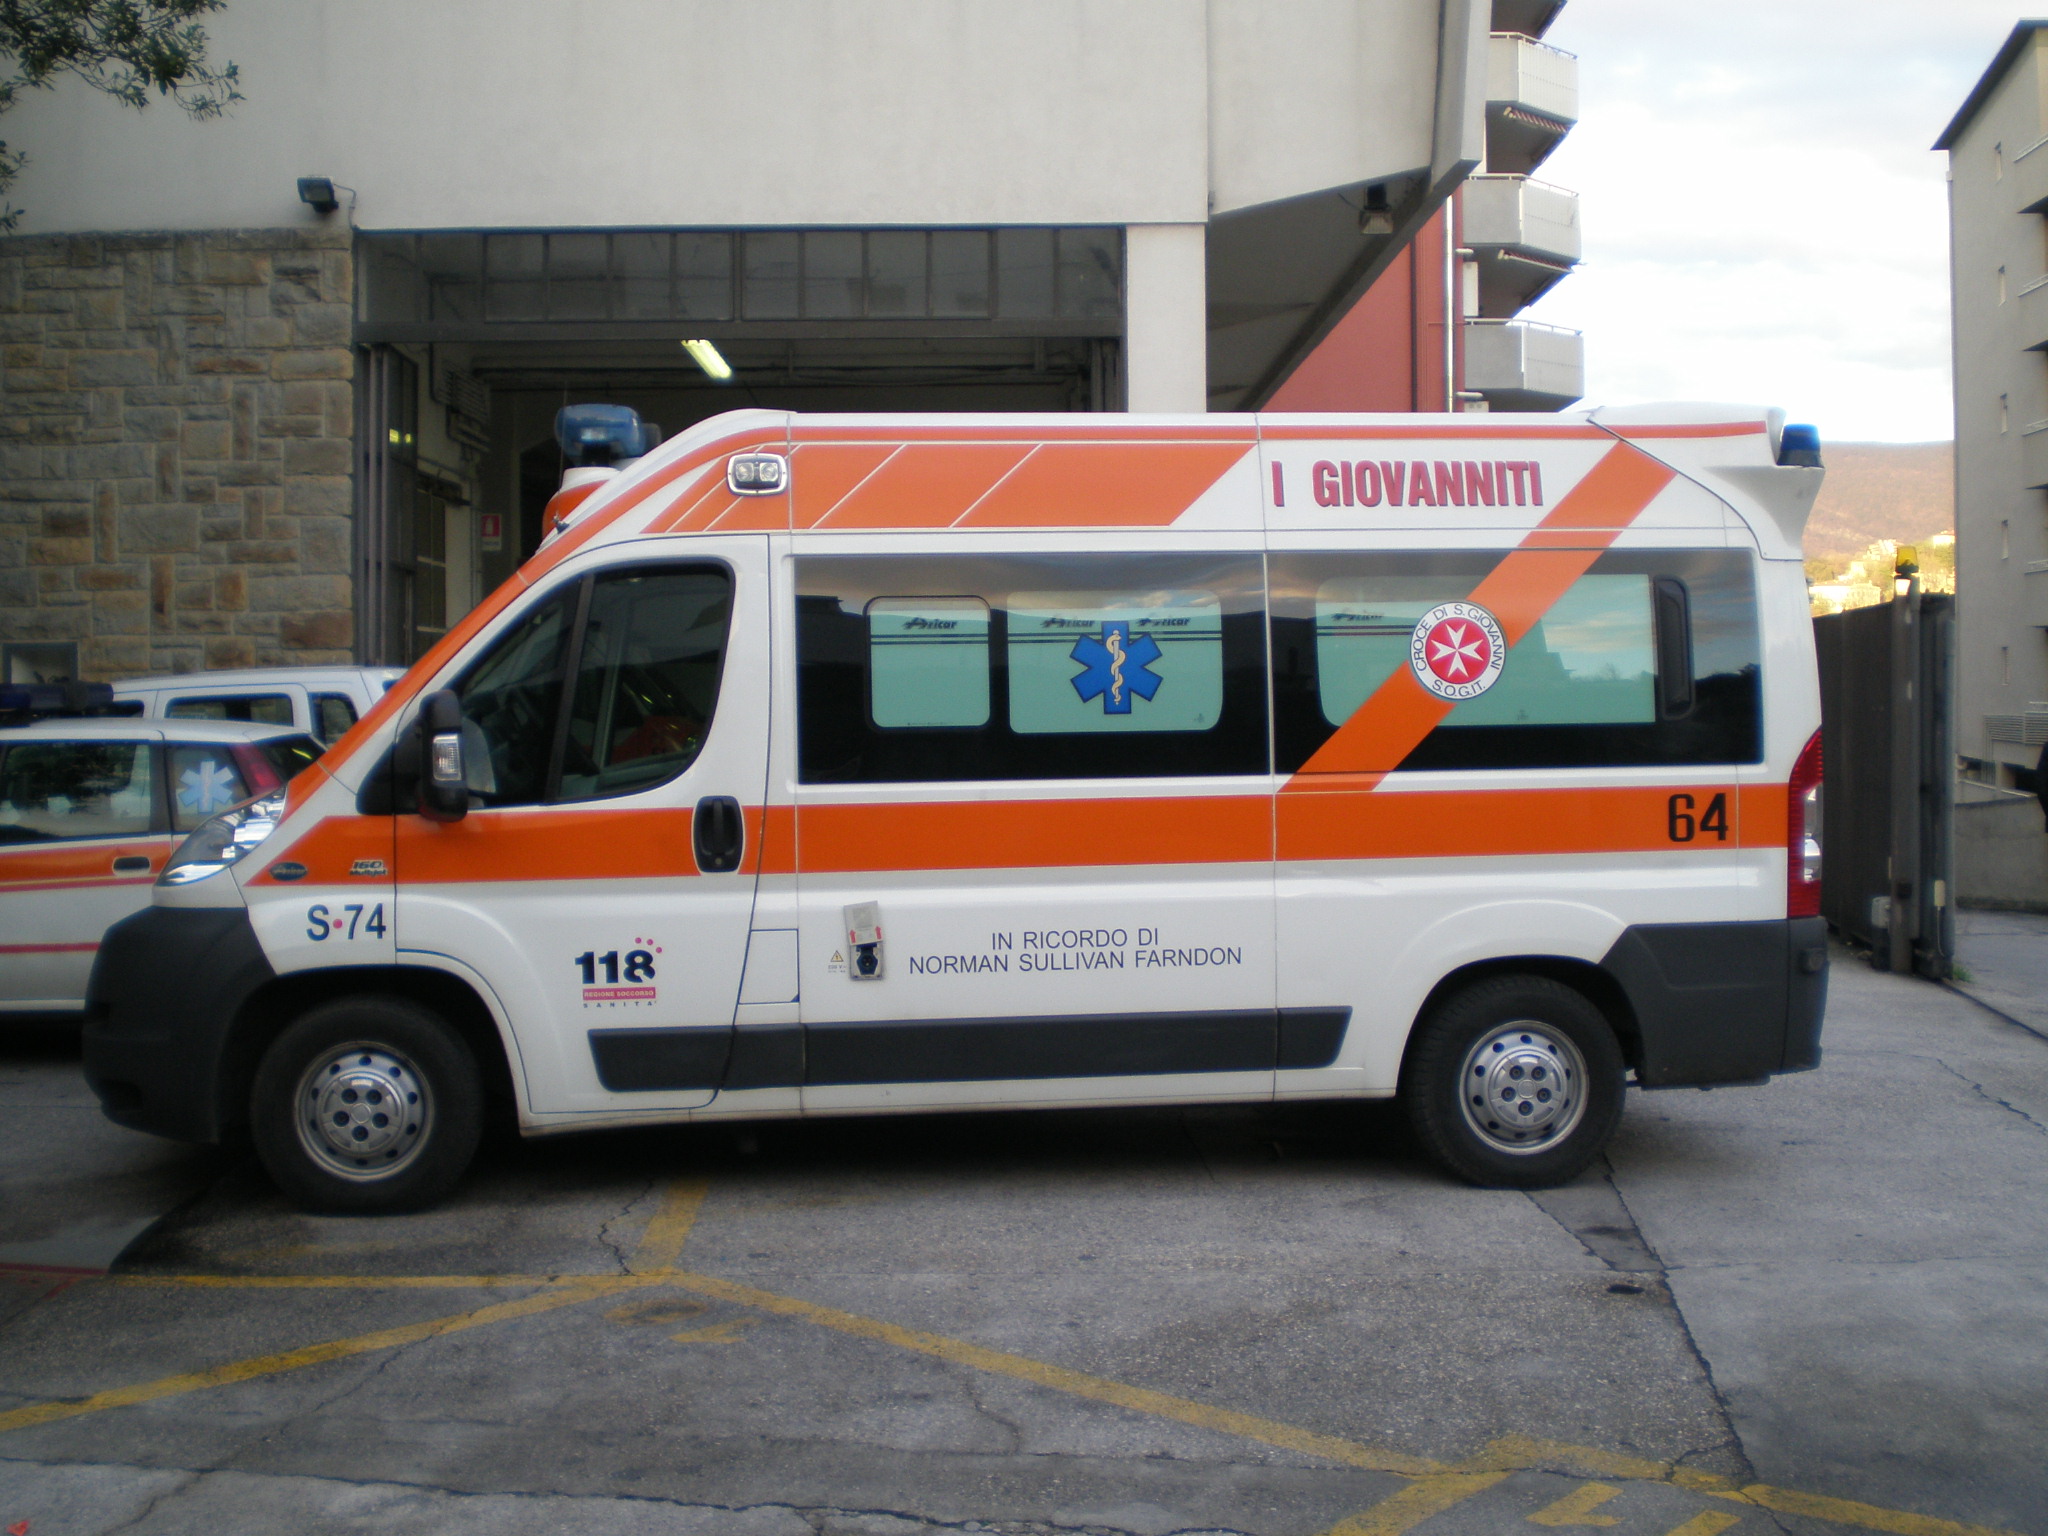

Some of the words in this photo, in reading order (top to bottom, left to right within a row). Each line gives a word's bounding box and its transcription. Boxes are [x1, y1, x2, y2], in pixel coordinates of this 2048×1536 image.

[1271, 460, 1284, 507] I
[1311, 459, 1544, 508] GIOVANNITI
[1412, 619, 1432, 672] CROCE
[1432, 607, 1448, 621] DI
[1668, 792, 1729, 842] 64
[992, 932, 1012, 950] IN
[1023, 928, 1128, 949] RICORDO
[1138, 928, 1159, 946] DI
[575, 949, 655, 984] 118
[909, 954, 1009, 975] NORMAN
[1018, 950, 1125, 972] SULLIVAN
[1135, 946, 1242, 968] FARNDON
